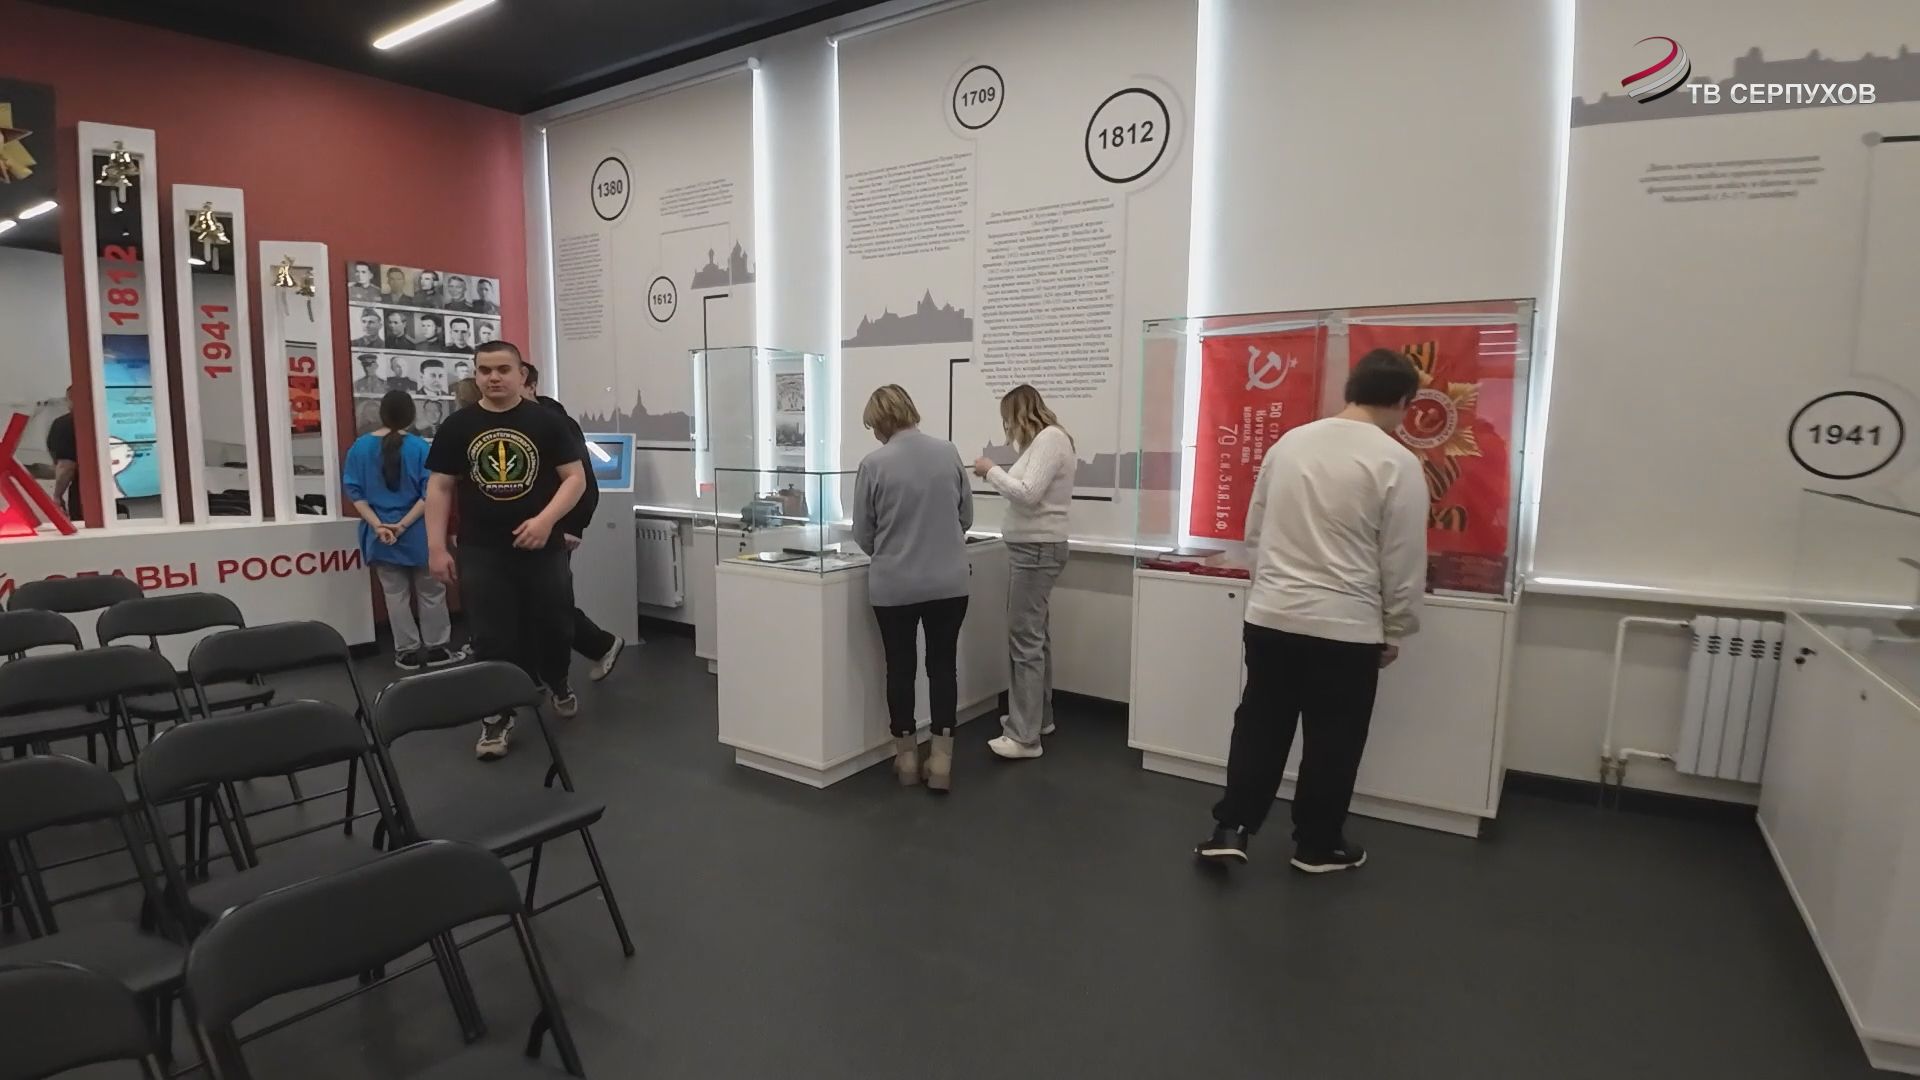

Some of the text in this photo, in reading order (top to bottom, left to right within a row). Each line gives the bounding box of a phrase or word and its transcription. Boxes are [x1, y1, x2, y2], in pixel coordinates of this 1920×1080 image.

[961, 86, 996, 107] 1709
[1098, 120, 1154, 149] 1812
[597, 179, 623, 198] 1380
[104, 245, 140, 325] 1812
[652, 293, 673, 305] 1612
[200, 304, 232, 378] 1941
[287, 355, 321, 433] 1945
[1269, 402, 1282, 418] 150
[1217, 423, 1239, 446] 79
[1809, 424, 1882, 446] 1941
[218, 548, 362, 584] РОССИИ
